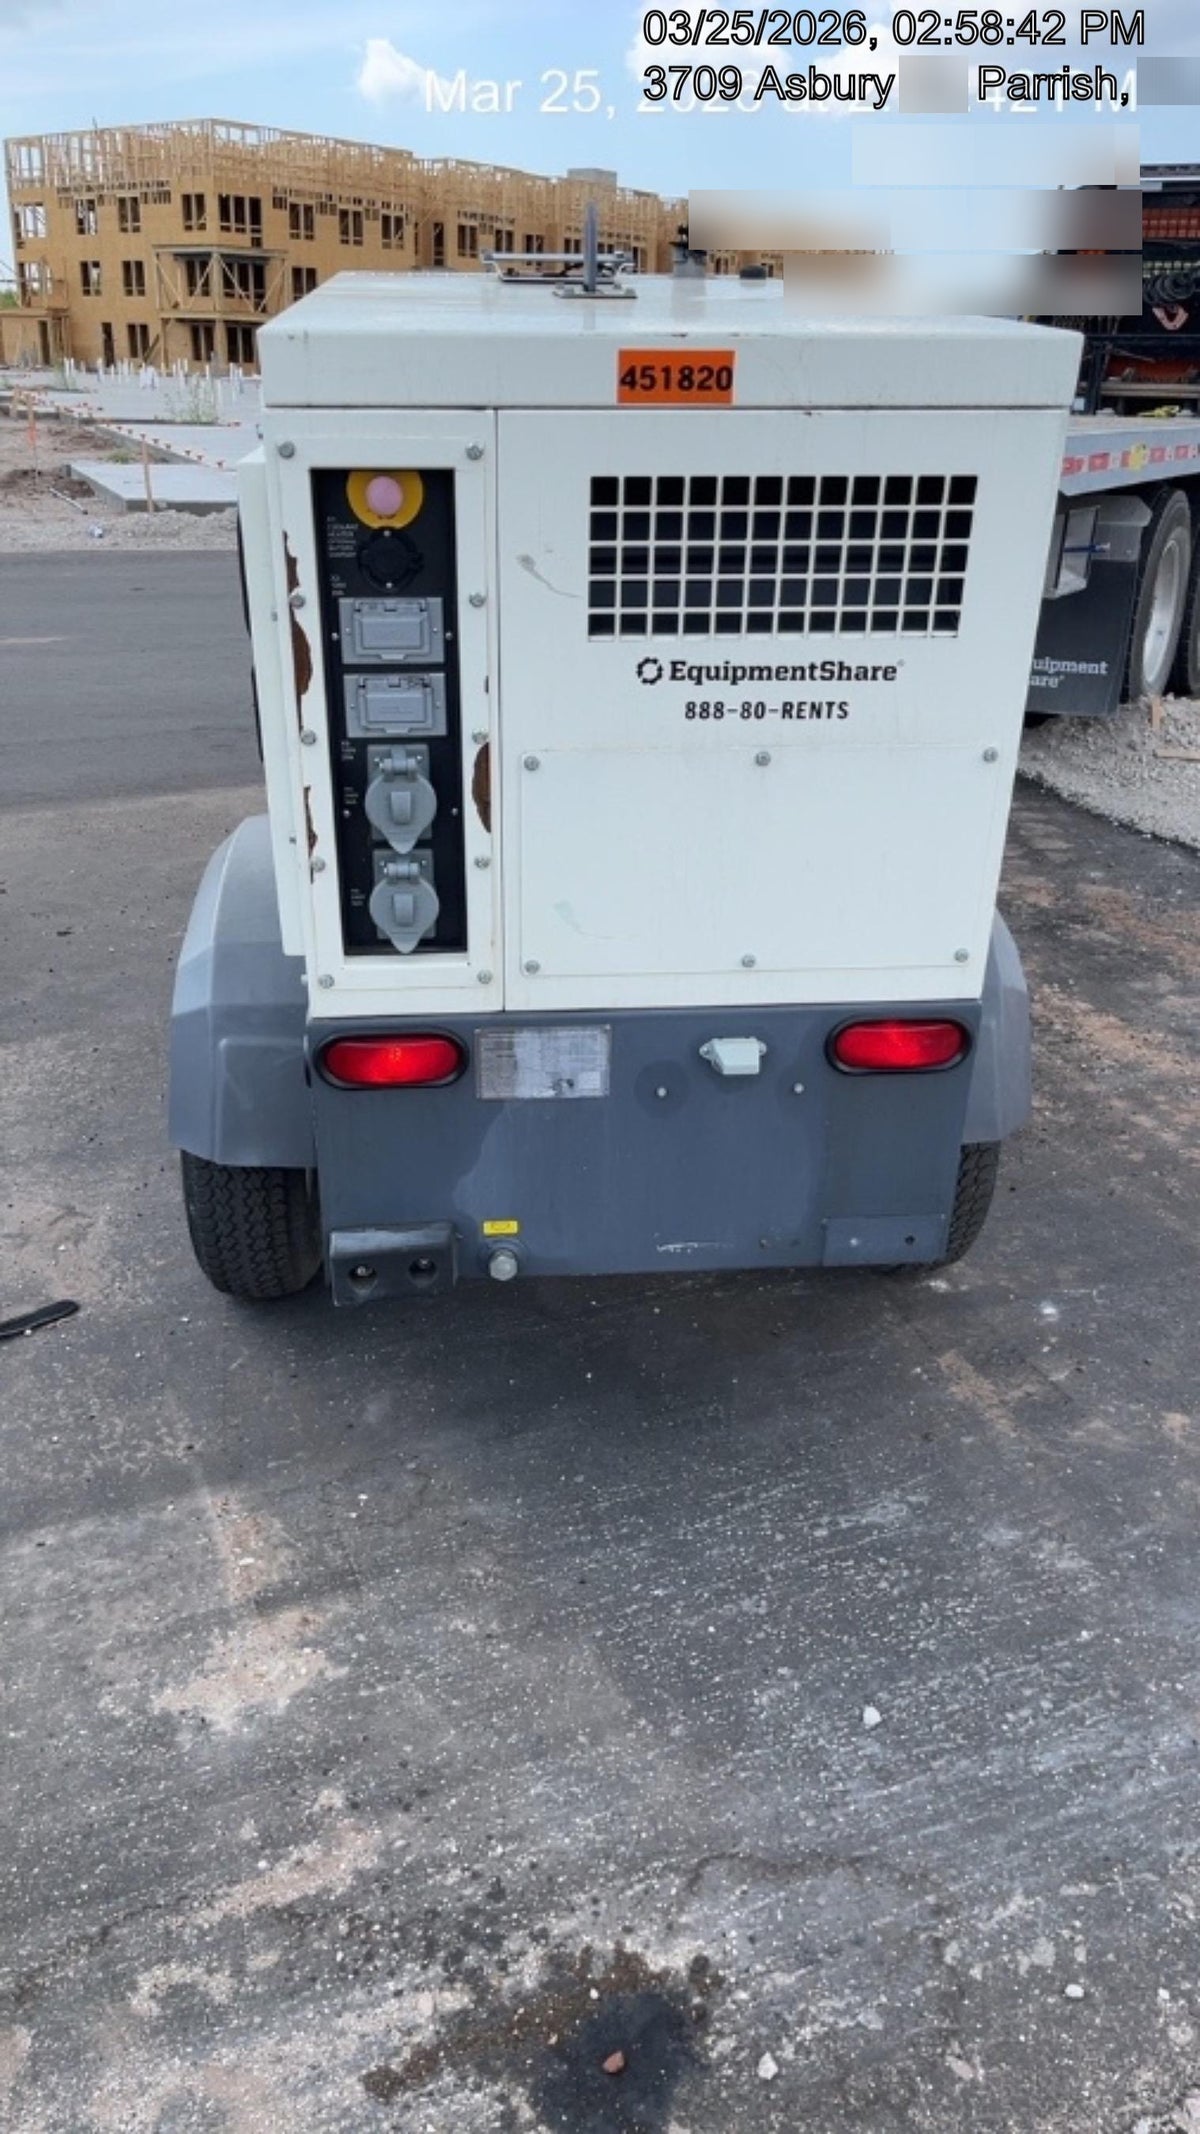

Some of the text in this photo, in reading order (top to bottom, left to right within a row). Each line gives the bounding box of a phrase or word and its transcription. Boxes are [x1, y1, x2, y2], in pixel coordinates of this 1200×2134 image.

[620, 364, 734, 391] 451820
[669, 660, 898, 686] EquipmentShare
[1033, 656, 1108, 674] uipment
[684, 701, 850, 721] 888-80-RENTS
